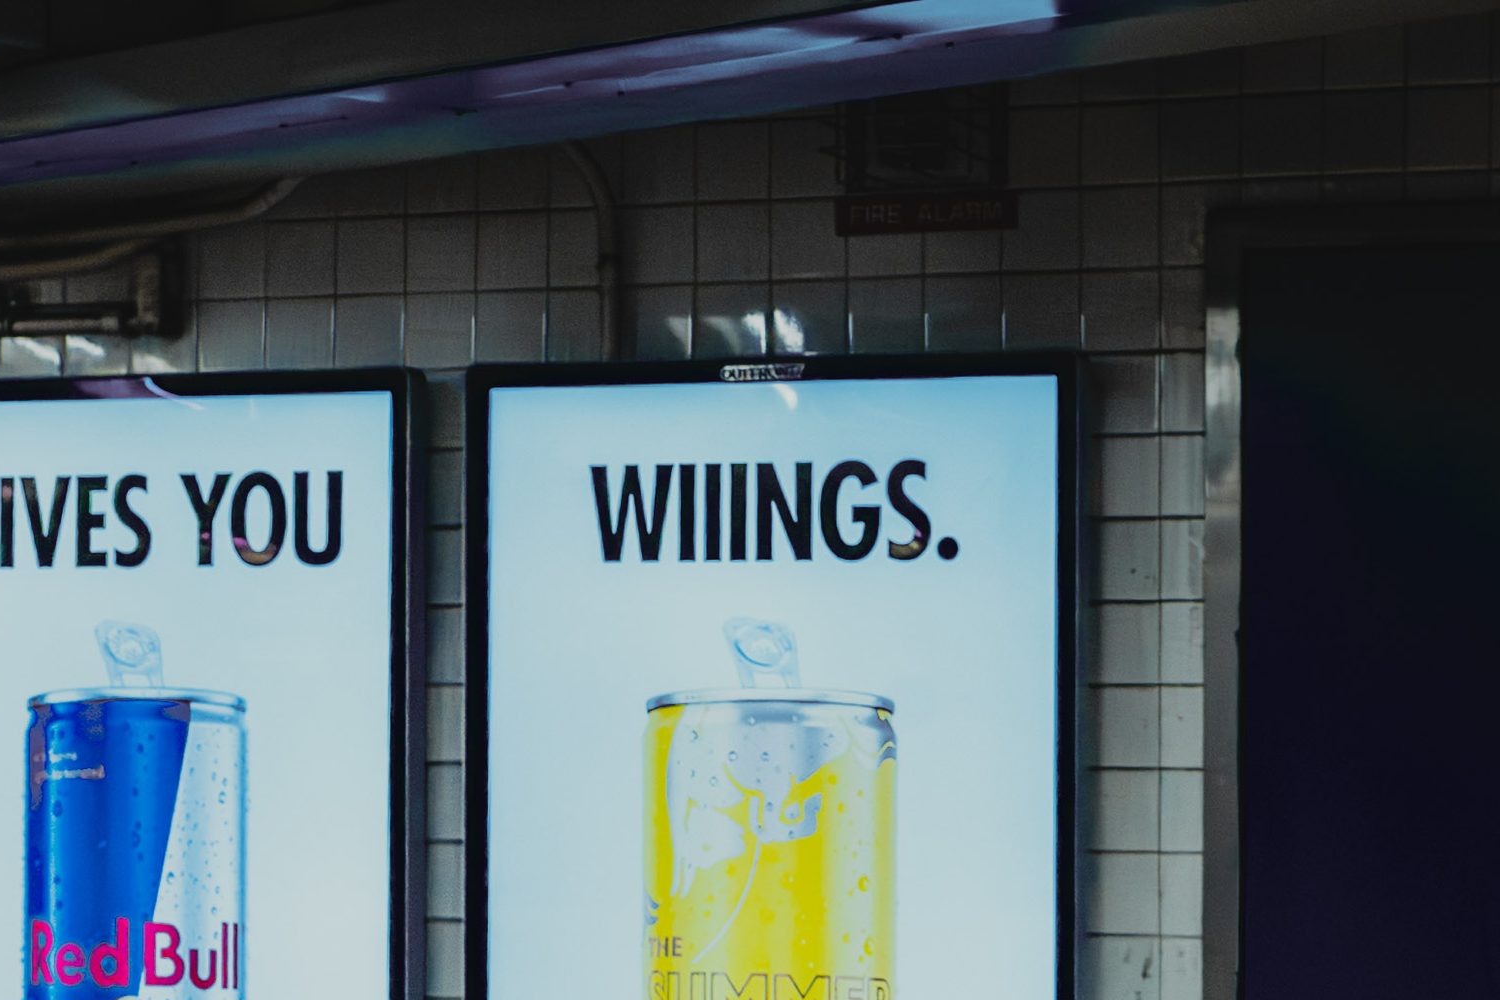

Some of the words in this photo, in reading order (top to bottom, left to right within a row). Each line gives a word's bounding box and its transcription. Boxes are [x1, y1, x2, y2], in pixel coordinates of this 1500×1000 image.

[851, 203, 900, 224] FIRE
[917, 201, 1002, 224] ALARM
[180, 470, 344, 567] YOU
[589, 459, 959, 562] WIIINGS.
[31, 917, 129, 988] Red
[144, 921, 238, 990] Bull
[648, 936, 683, 958] THE
